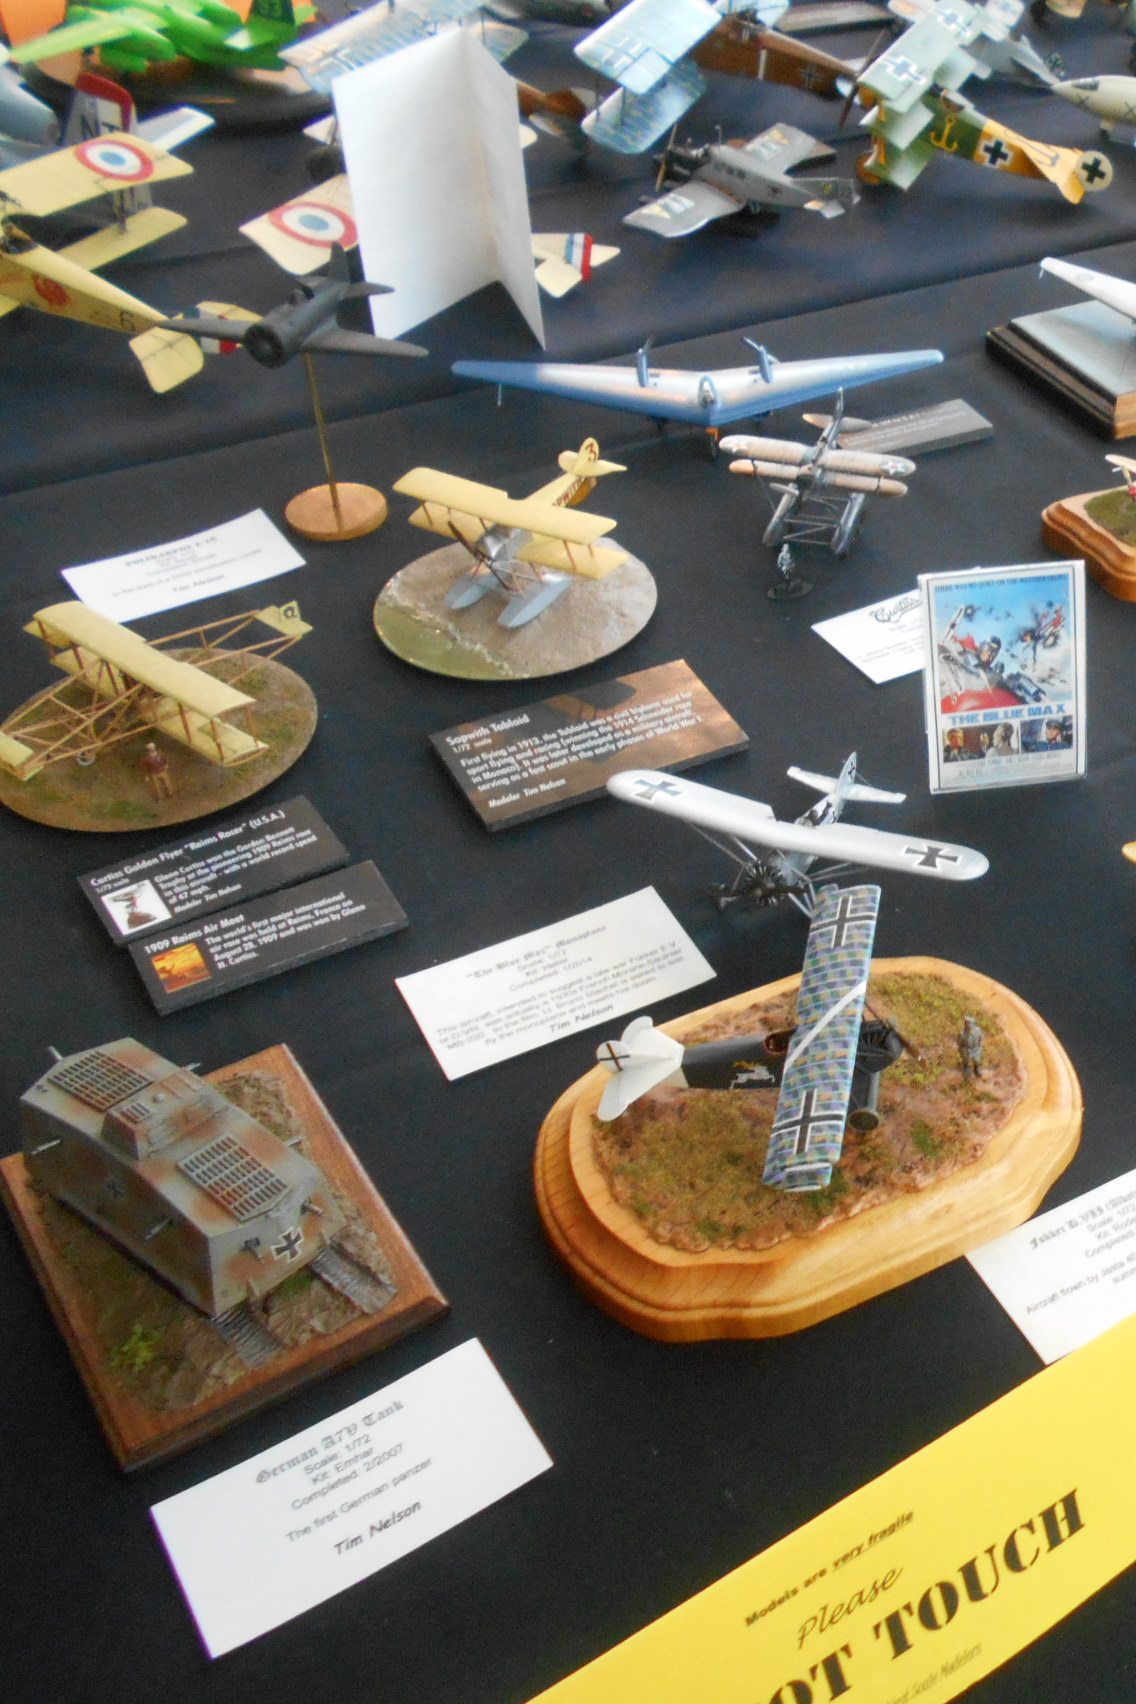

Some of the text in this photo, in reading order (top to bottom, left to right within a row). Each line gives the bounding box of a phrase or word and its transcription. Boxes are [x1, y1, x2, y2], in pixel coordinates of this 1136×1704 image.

[585, 441, 598, 463] 3
[446, 714, 530, 746] Sopwith Tabloid
[949, 704, 1066, 726] THE BLUE MAX
[90, 871, 124, 886] Curtiss
[124, 858, 159, 874] Golden
[159, 849, 183, 861] Flyer
[249, 810, 285, 828] (U.S.A.)
[144, 914, 244, 954] 1909 Reims Air Meet
[550, 1005, 613, 1032] Tim Nelson
[256, 1447, 318, 1483] German
[362, 1401, 404, 1426] Tank
[304, 1434, 371, 1474] Scale: 1/72
[334, 1447, 373, 1473] Emhar
[286, 1458, 431, 1541] The first German panzer
[292, 1443, 402, 1510] Completed: 2/2007
[334, 1502, 420, 1554] Tim Nelson
[745, 1510, 915, 1628] Models are very fragile
[872, 1487, 1086, 1661] TOUCH
[797, 1565, 904, 1651] Please
